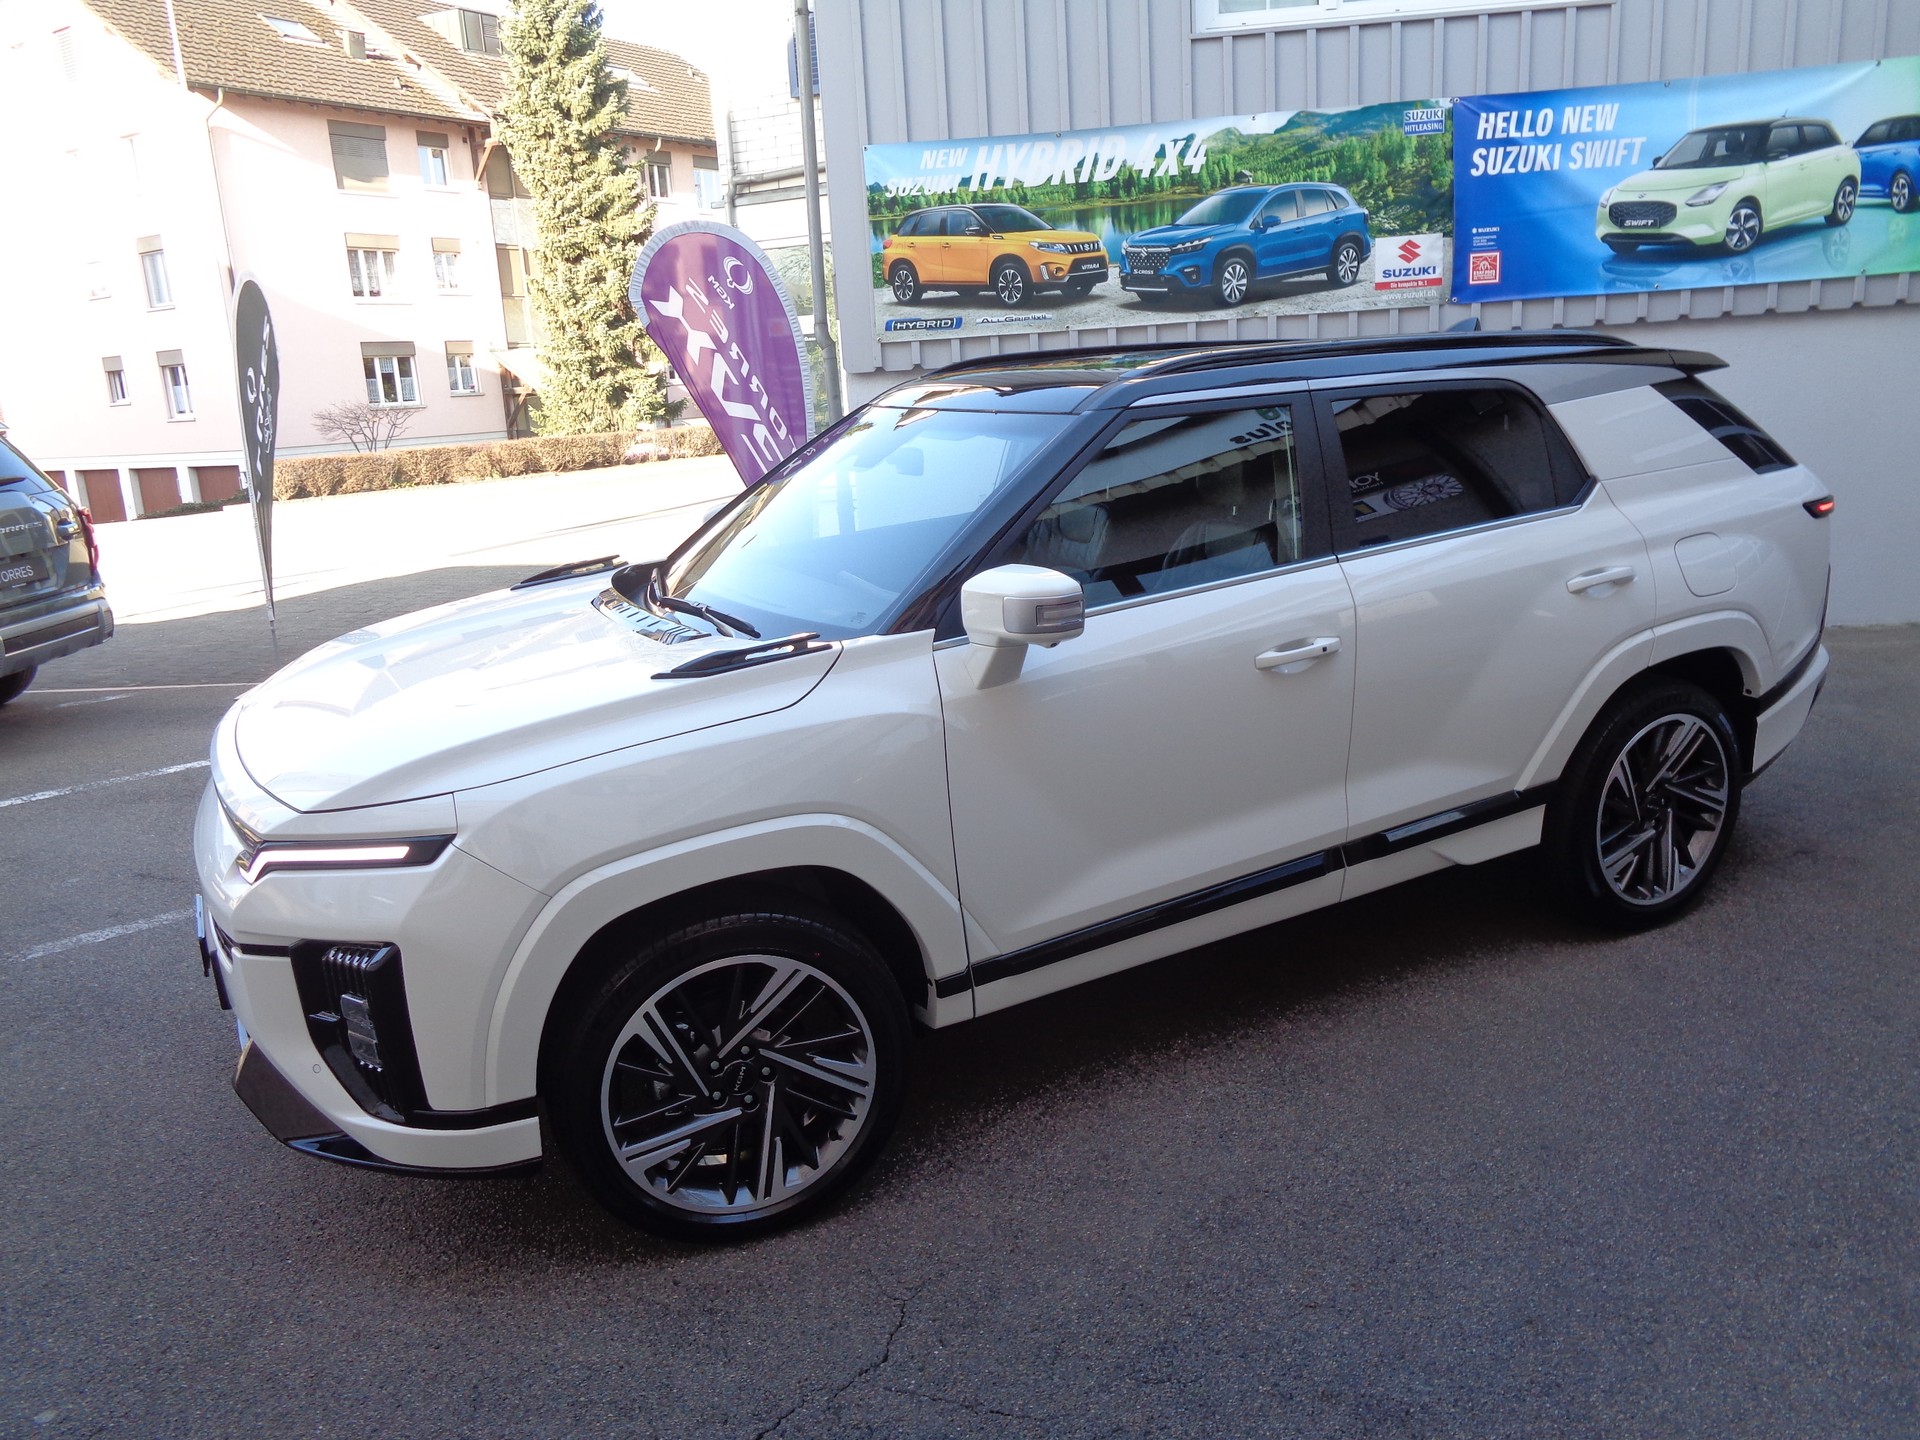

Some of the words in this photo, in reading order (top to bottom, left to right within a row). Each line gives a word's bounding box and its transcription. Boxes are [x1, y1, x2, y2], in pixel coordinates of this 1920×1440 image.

[1404, 109, 1444, 122] SUZUKI
[1477, 108, 1554, 140] HELLO
[1561, 103, 1620, 135] NEW
[1404, 122, 1443, 133] HITLEASING
[920, 147, 969, 170] NEW
[969, 135, 1127, 192] HYBRID
[1470, 143, 1562, 177] SUZUKI
[1568, 136, 1647, 170] SWIFT
[884, 173, 962, 198] SUZUKI
[1624, 219, 1655, 227] SWIFT
[1382, 265, 1437, 279] SUZUKI
[0, 565, 34, 584] ORRES
[734, 1066, 746, 1091] KGM
